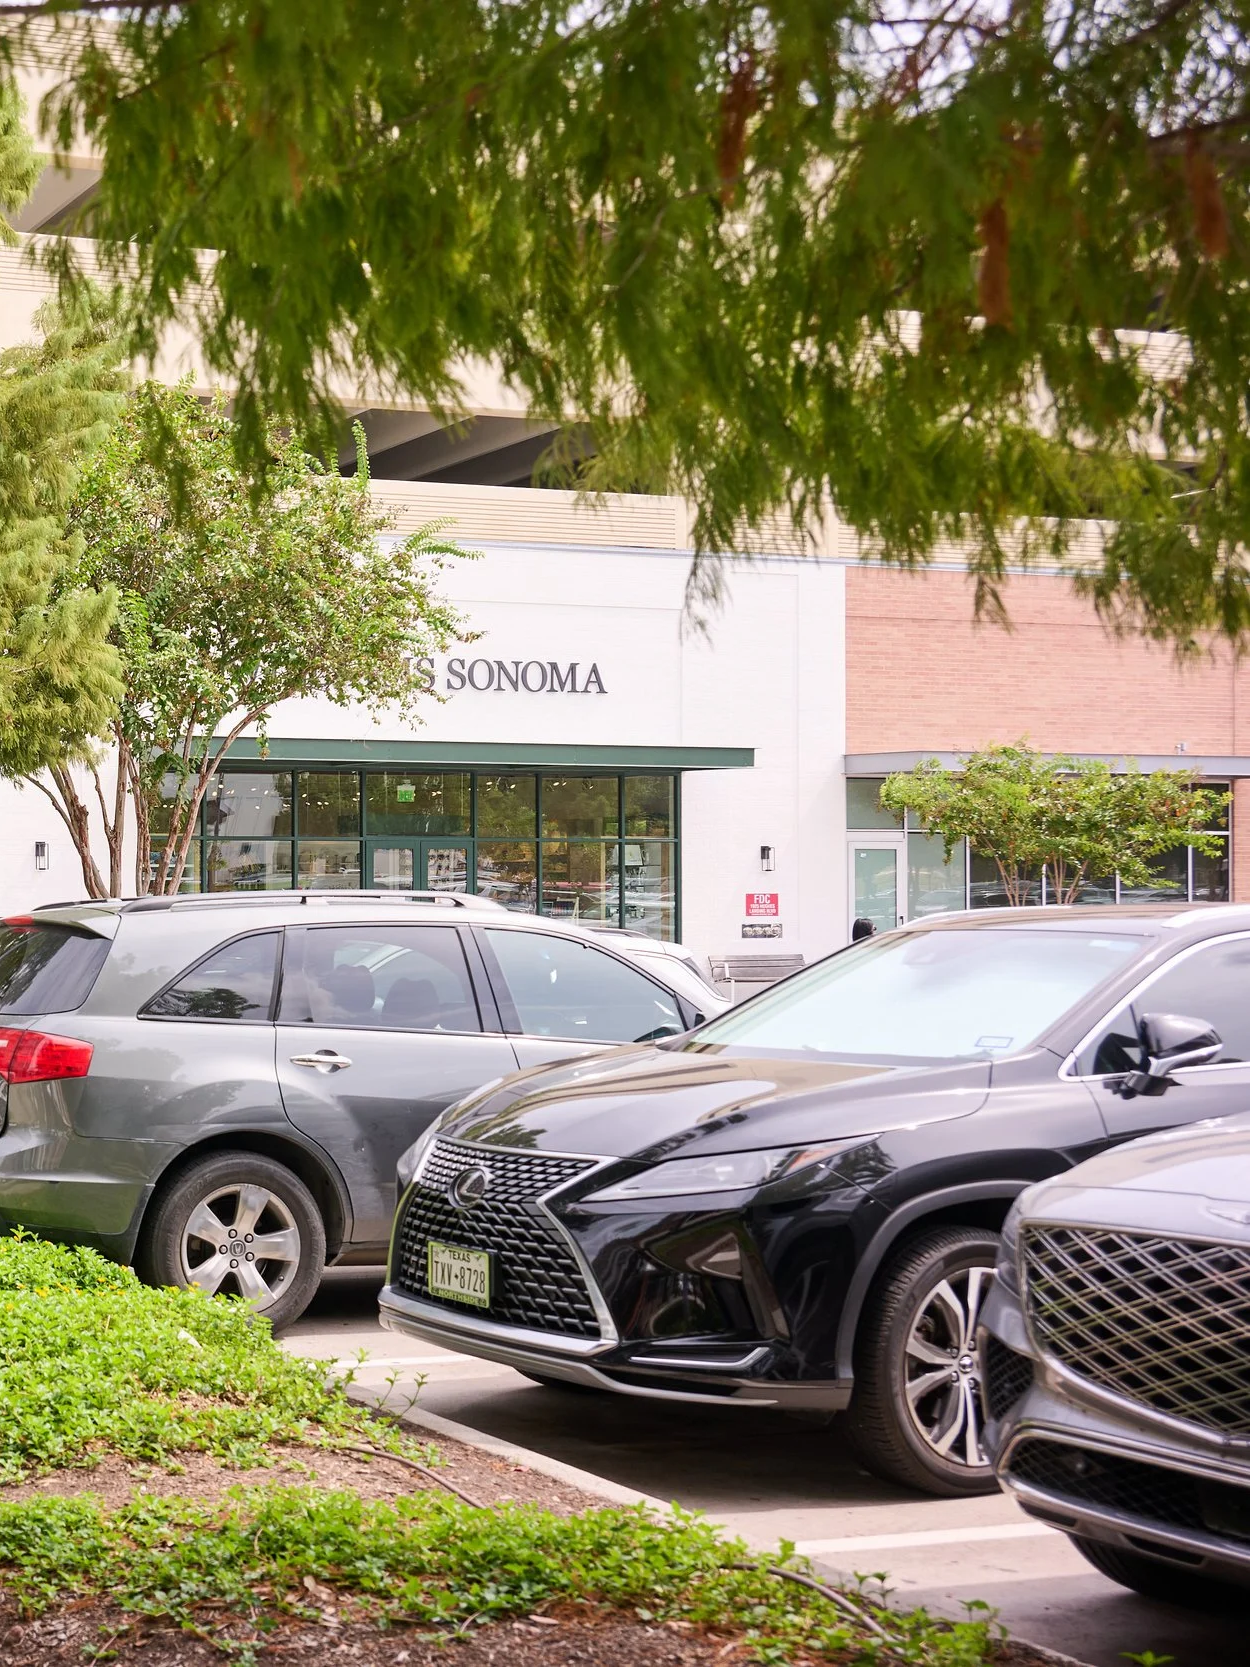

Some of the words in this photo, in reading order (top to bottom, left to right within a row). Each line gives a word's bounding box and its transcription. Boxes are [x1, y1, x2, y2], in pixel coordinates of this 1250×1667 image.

[446, 658, 608, 694] SONOMA
[754, 894, 771, 904] FDC
[448, 1249, 471, 1263] TEXAS
